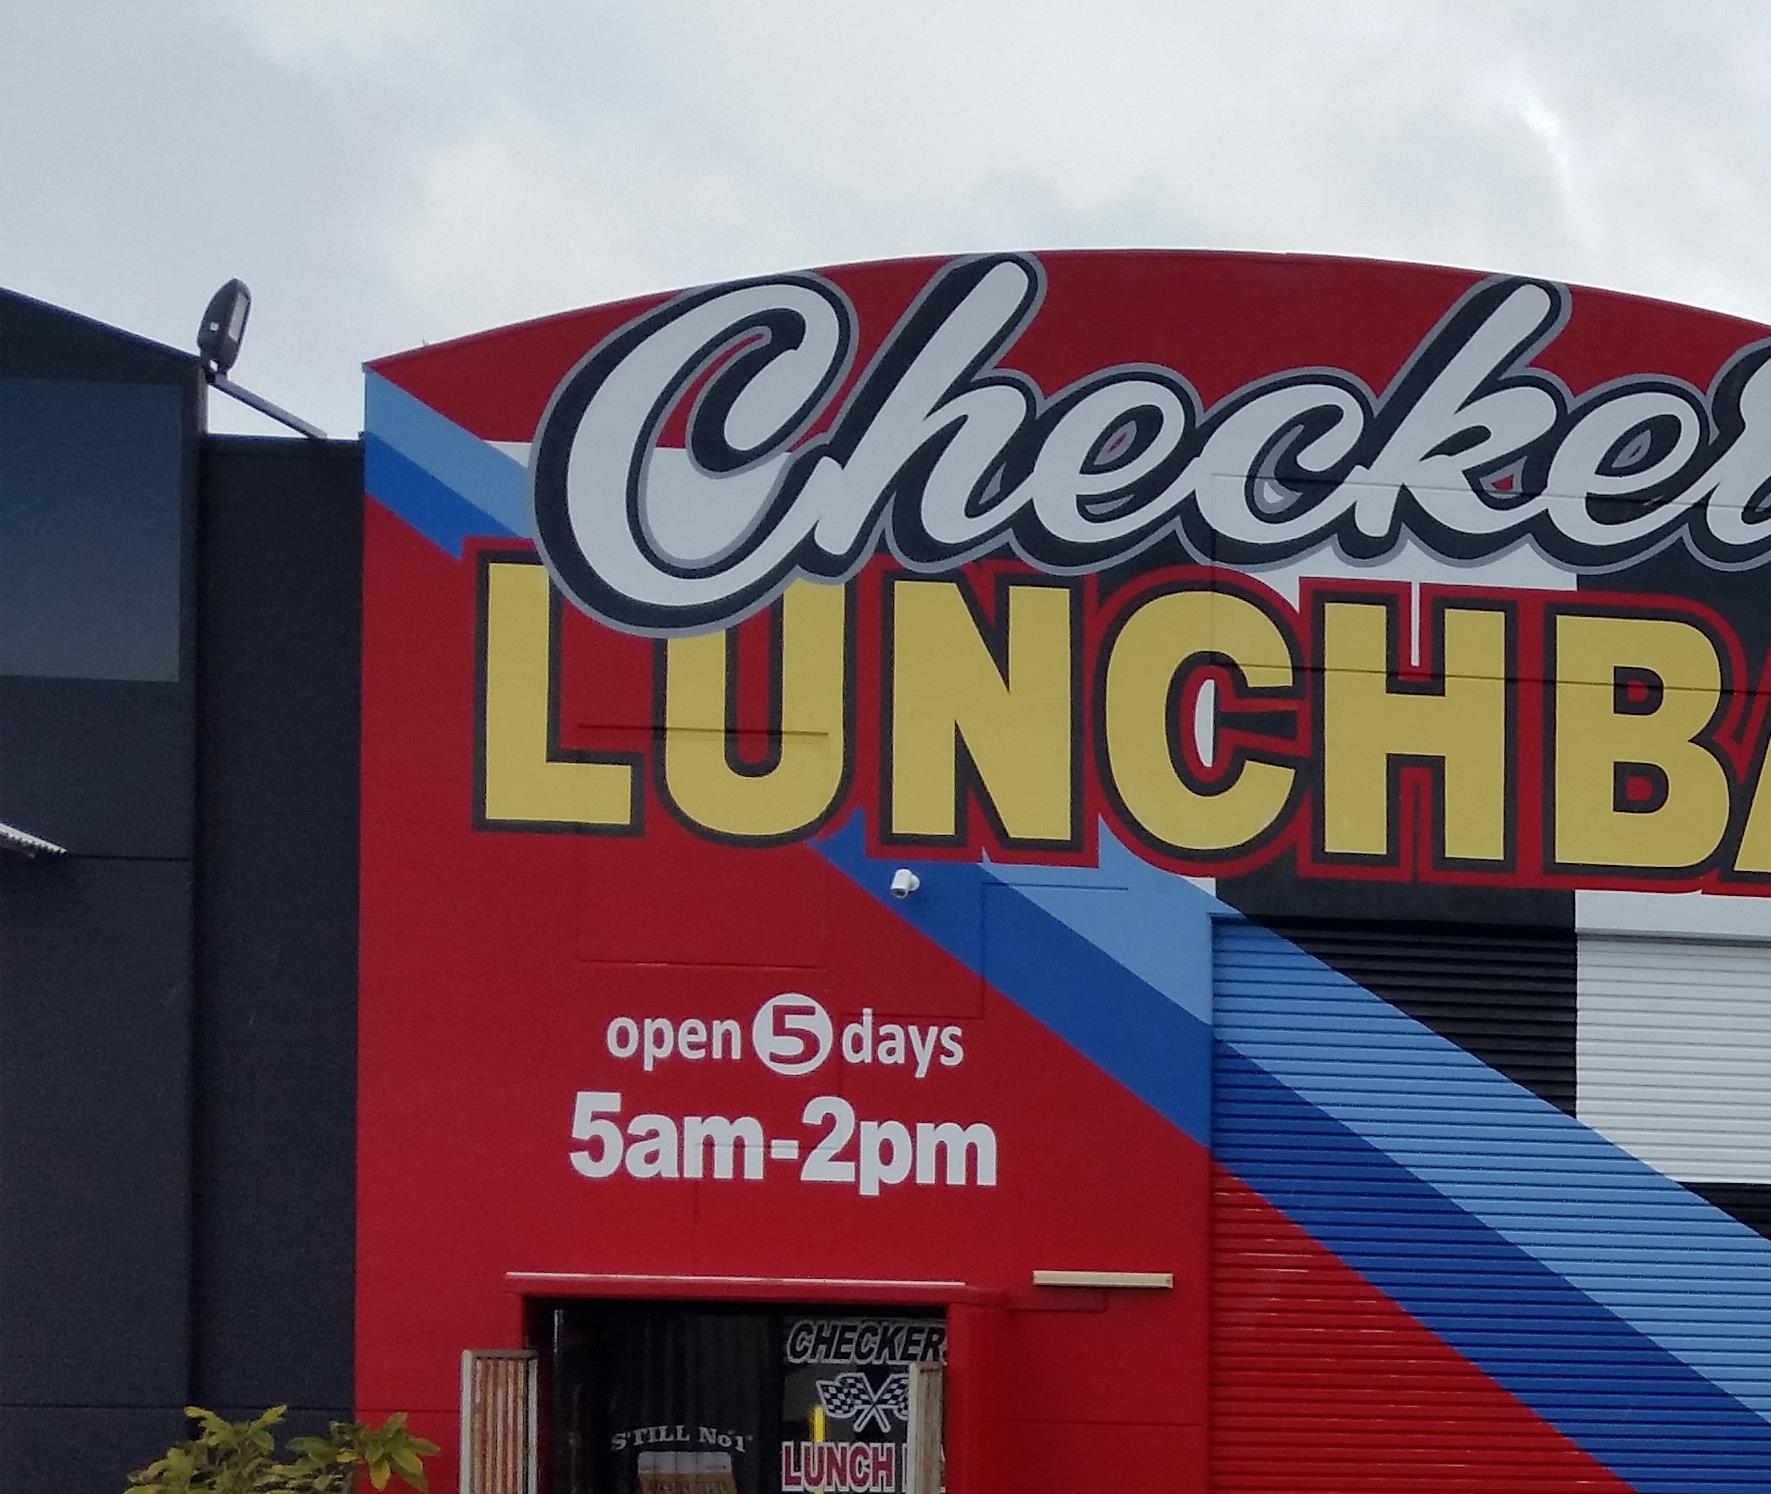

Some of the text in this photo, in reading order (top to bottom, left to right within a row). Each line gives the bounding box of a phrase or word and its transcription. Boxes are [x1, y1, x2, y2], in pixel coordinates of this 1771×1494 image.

[606, 1003, 965, 1078] open 5 days
[569, 1090, 998, 1196] 5am-2pm
[787, 1320, 949, 1365] CHECKER
[610, 1424, 691, 1451] STILL
[781, 1441, 896, 1493] LUNCH
